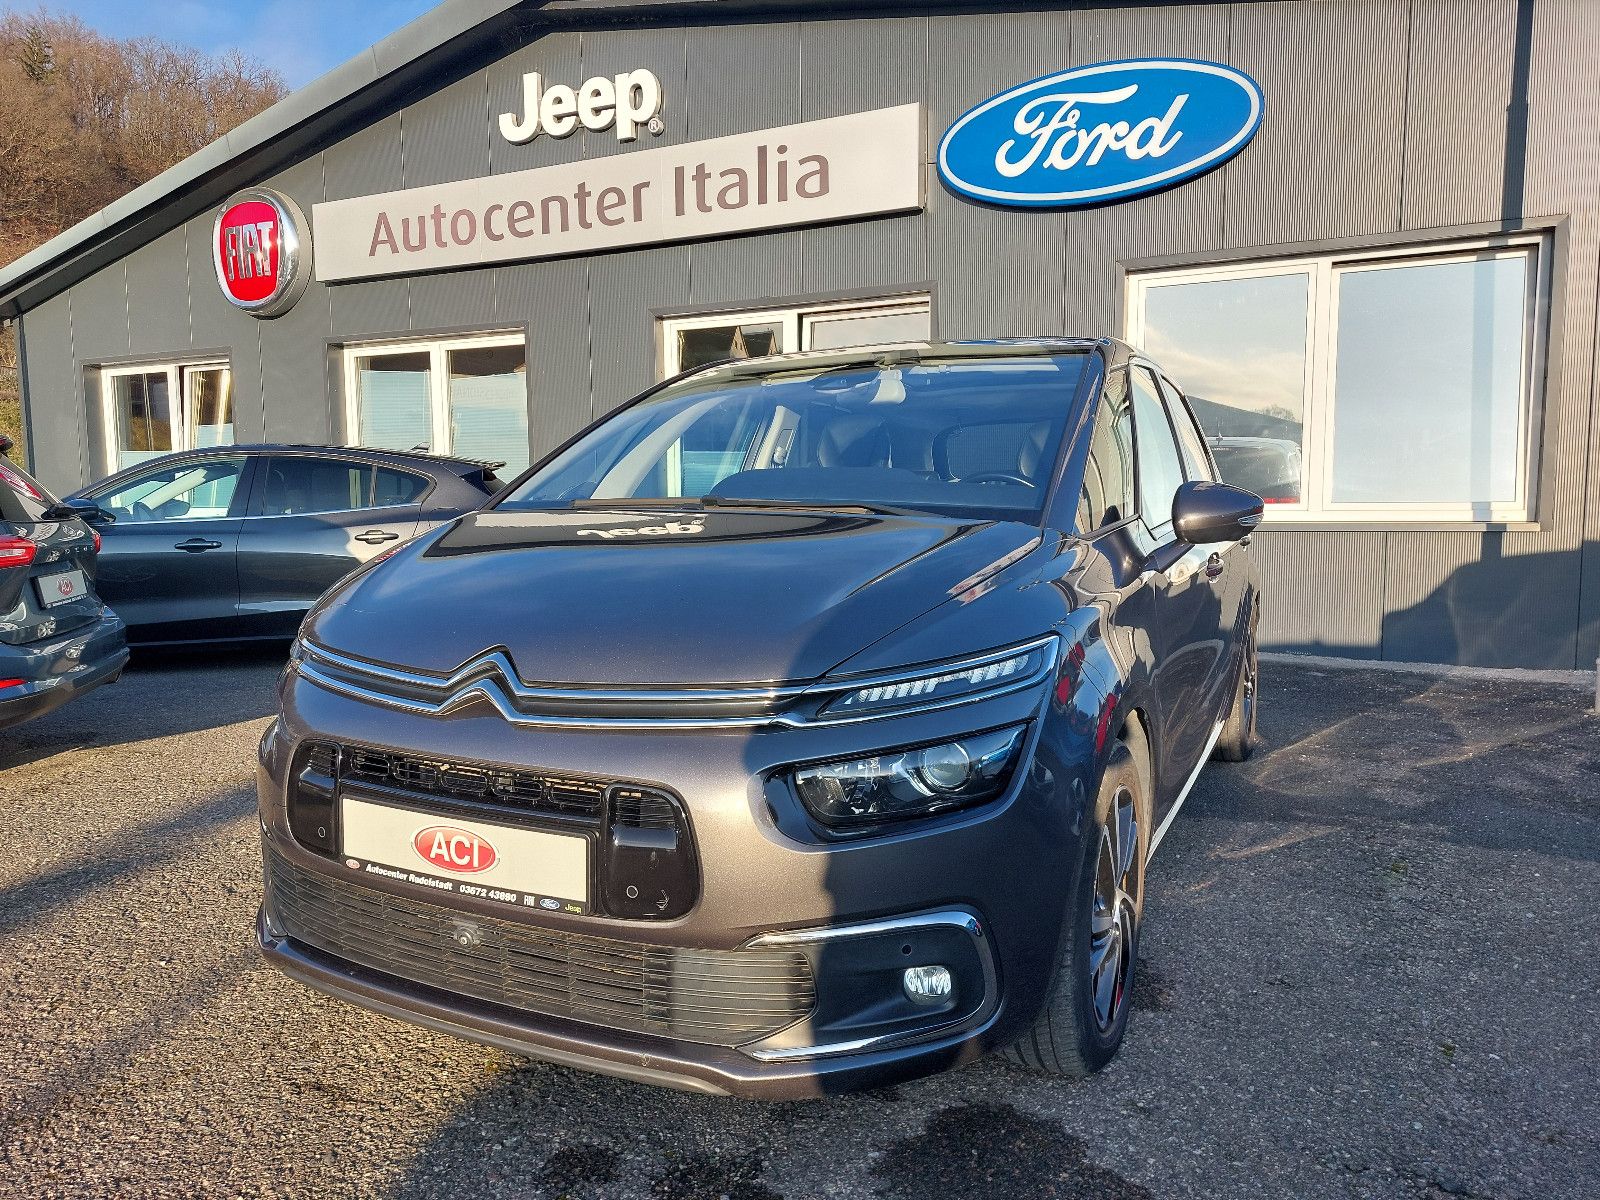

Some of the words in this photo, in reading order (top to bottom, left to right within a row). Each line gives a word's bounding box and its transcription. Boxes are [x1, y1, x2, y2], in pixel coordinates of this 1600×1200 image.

[994, 84, 1190, 178] Ford
[368, 180, 651, 257] Autocenter
[674, 144, 830, 217] Italia
[225, 221, 274, 281] FIAT
[365, 863, 408, 880] Autocenter
[430, 831, 479, 868] ACI
